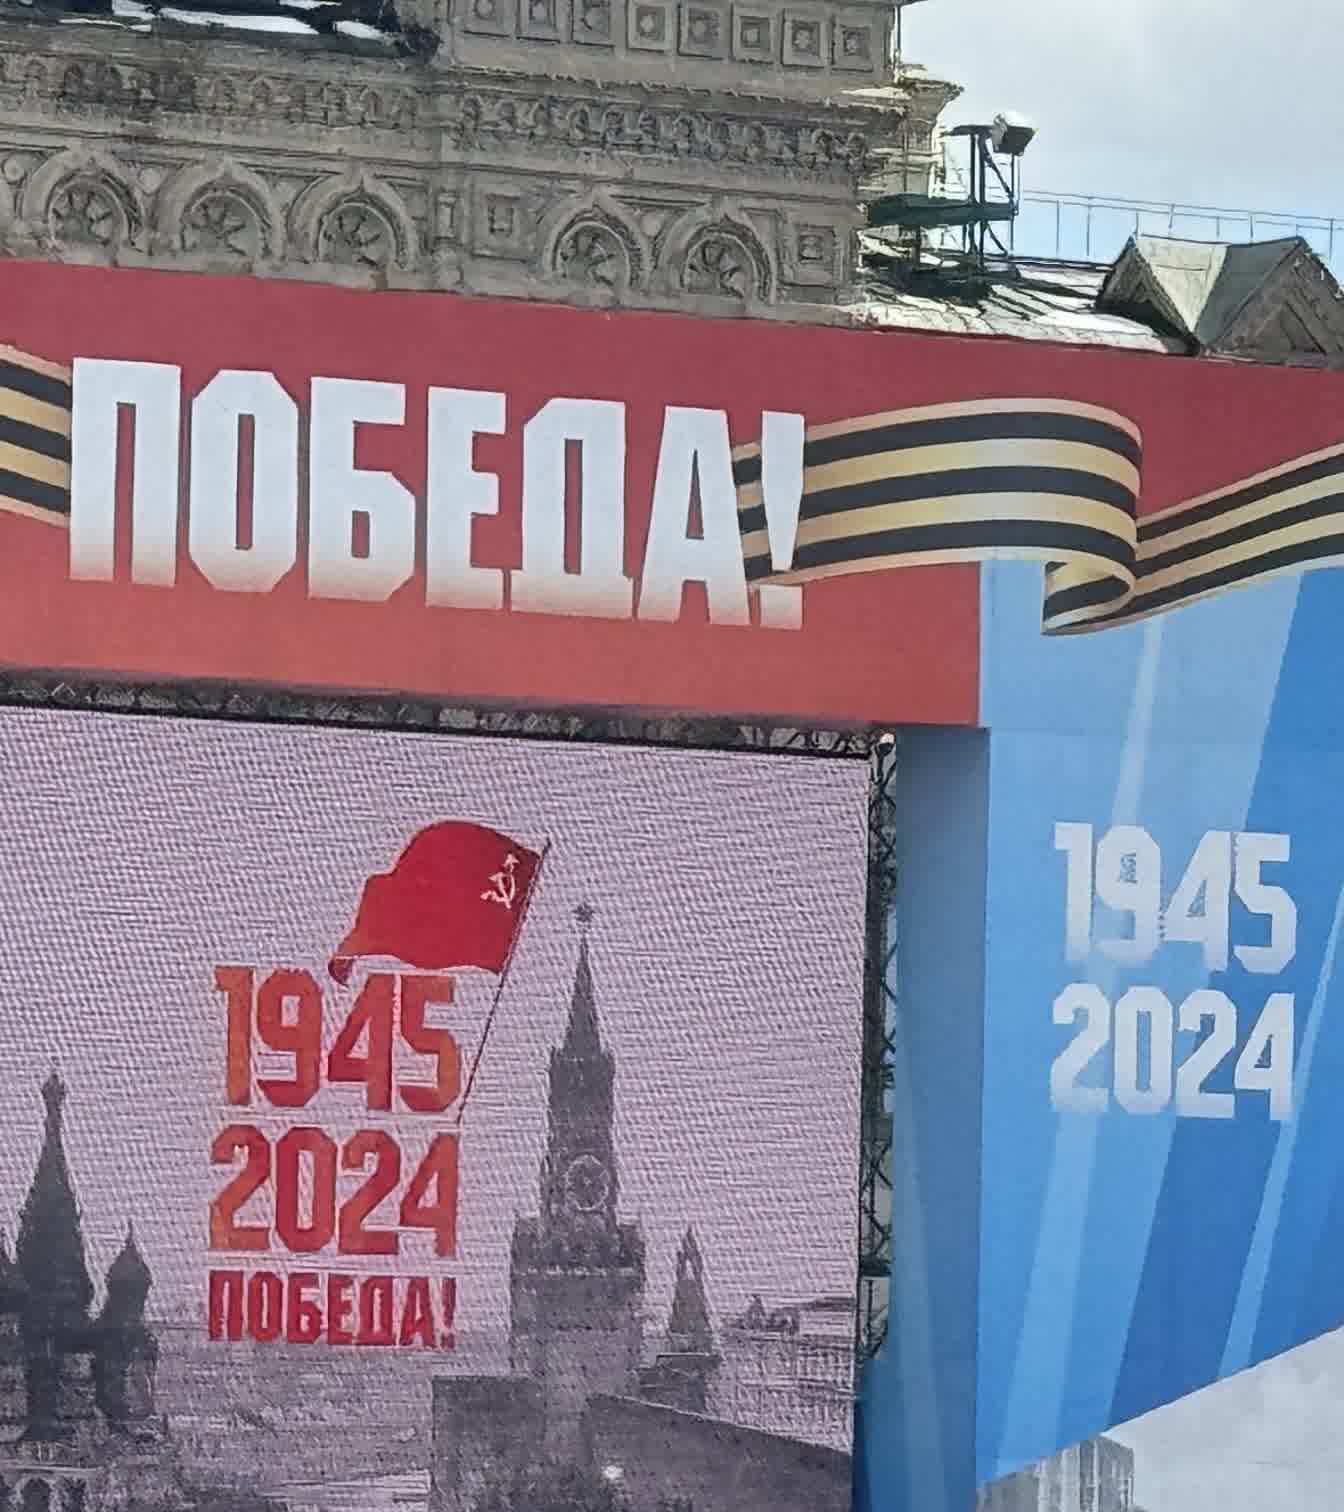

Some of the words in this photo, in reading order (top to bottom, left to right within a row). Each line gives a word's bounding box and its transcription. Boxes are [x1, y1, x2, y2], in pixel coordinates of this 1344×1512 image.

[68, 356, 806, 631] ПОБЕДА!
[1050, 820, 1298, 976] 1945
[213, 964, 463, 1114] 1945
[1049, 982, 1297, 1122] 2024
[208, 1123, 460, 1257] 2024
[207, 1269, 457, 1350] ПОБЕДА!
